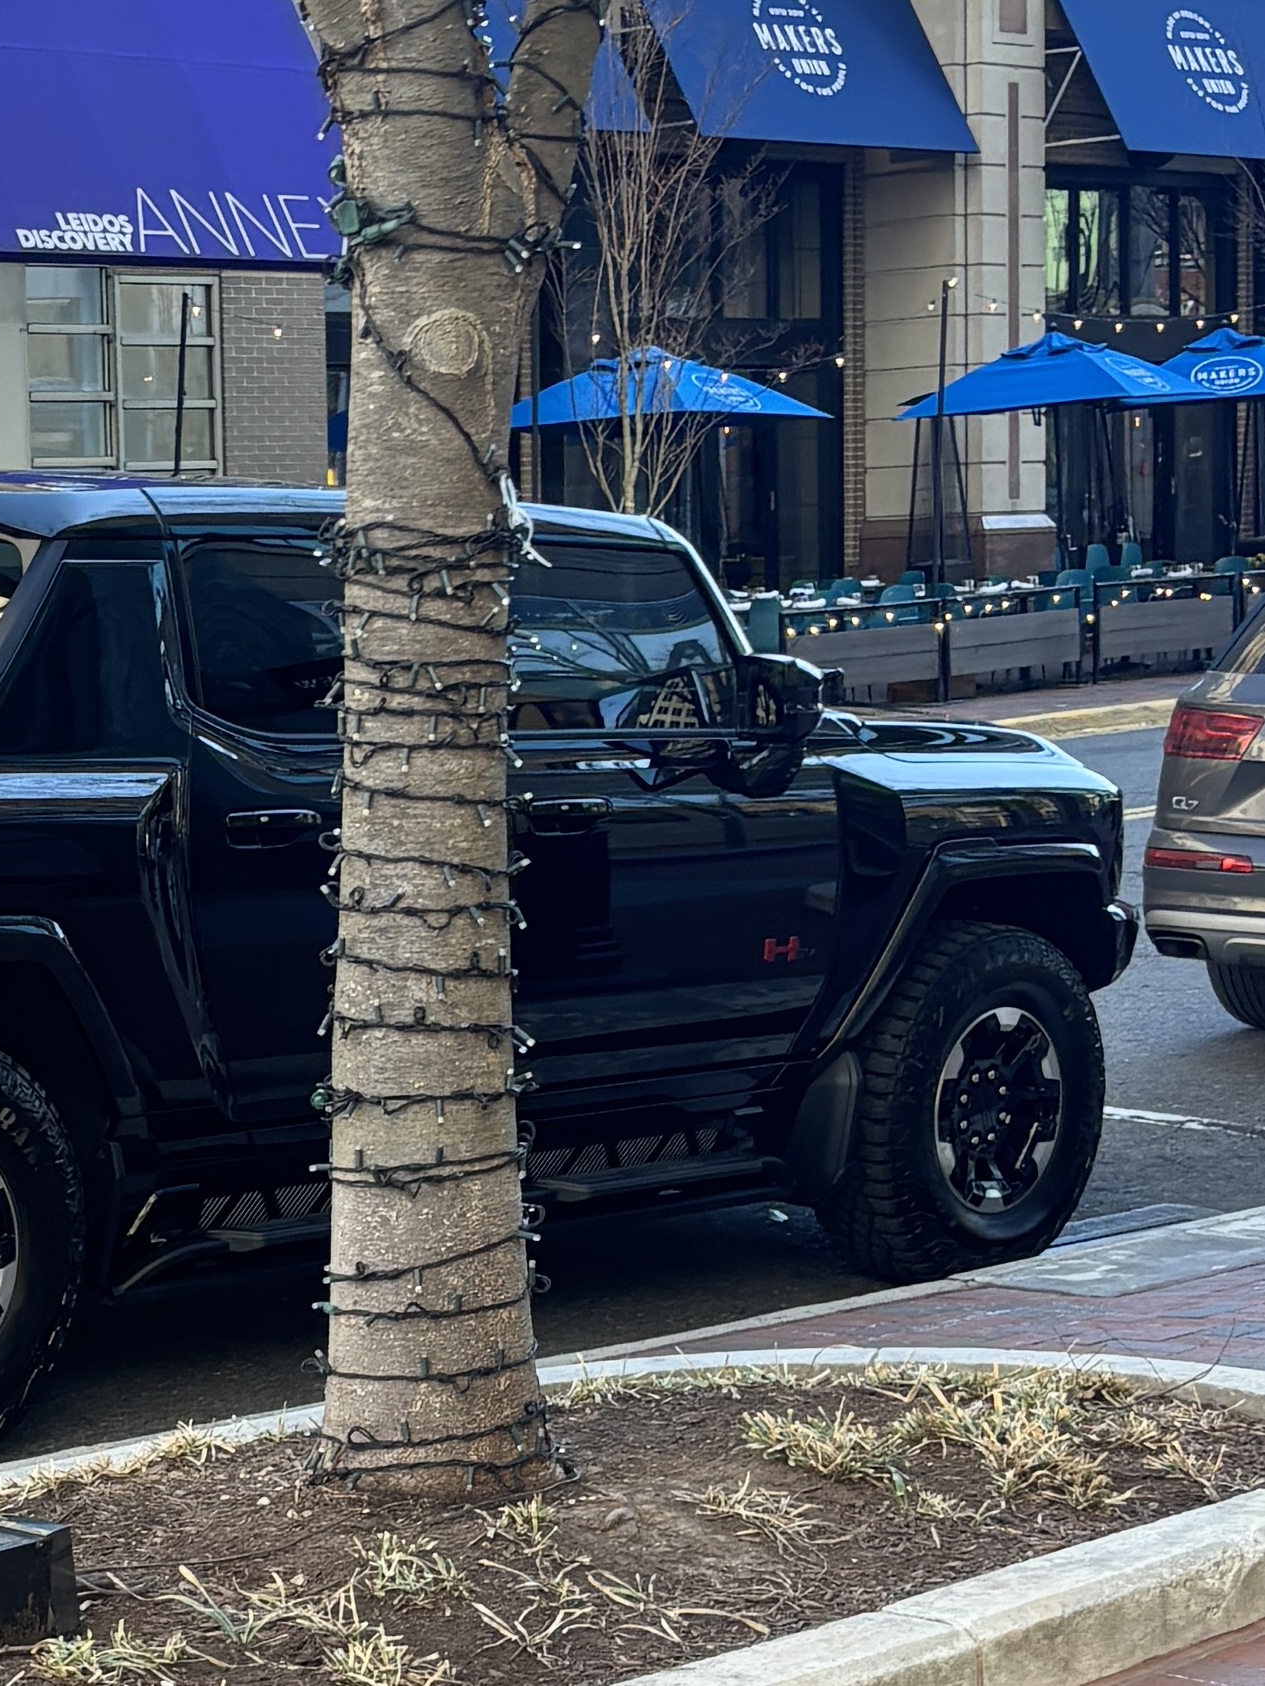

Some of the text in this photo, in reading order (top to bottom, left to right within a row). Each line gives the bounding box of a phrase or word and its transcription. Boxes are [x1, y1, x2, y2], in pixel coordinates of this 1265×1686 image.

[752, 22, 843, 56] MAKERS
[1167, 44, 1245, 76] MAKERS
[55, 212, 134, 233] LEIDOS
[15, 229, 134, 252] DISCOVERY
[1196, 367, 1256, 381] MAKERS
